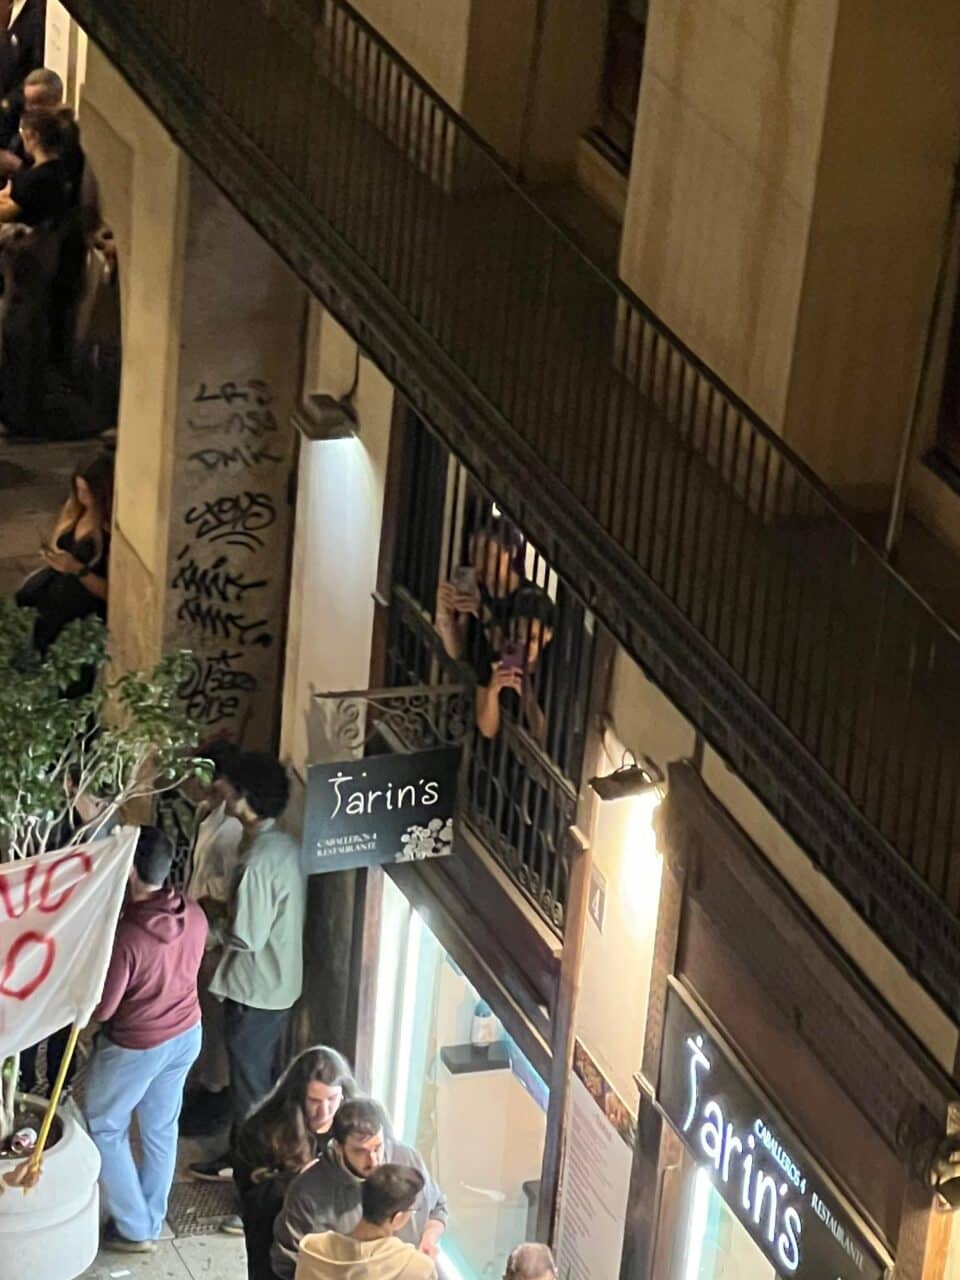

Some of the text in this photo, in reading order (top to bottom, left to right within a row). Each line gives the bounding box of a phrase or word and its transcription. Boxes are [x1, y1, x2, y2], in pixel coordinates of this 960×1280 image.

[327, 771, 439, 820] Tarin's
[682, 1035, 802, 1271] Tarin's
[753, 1118, 801, 1187] CABALLEROS
